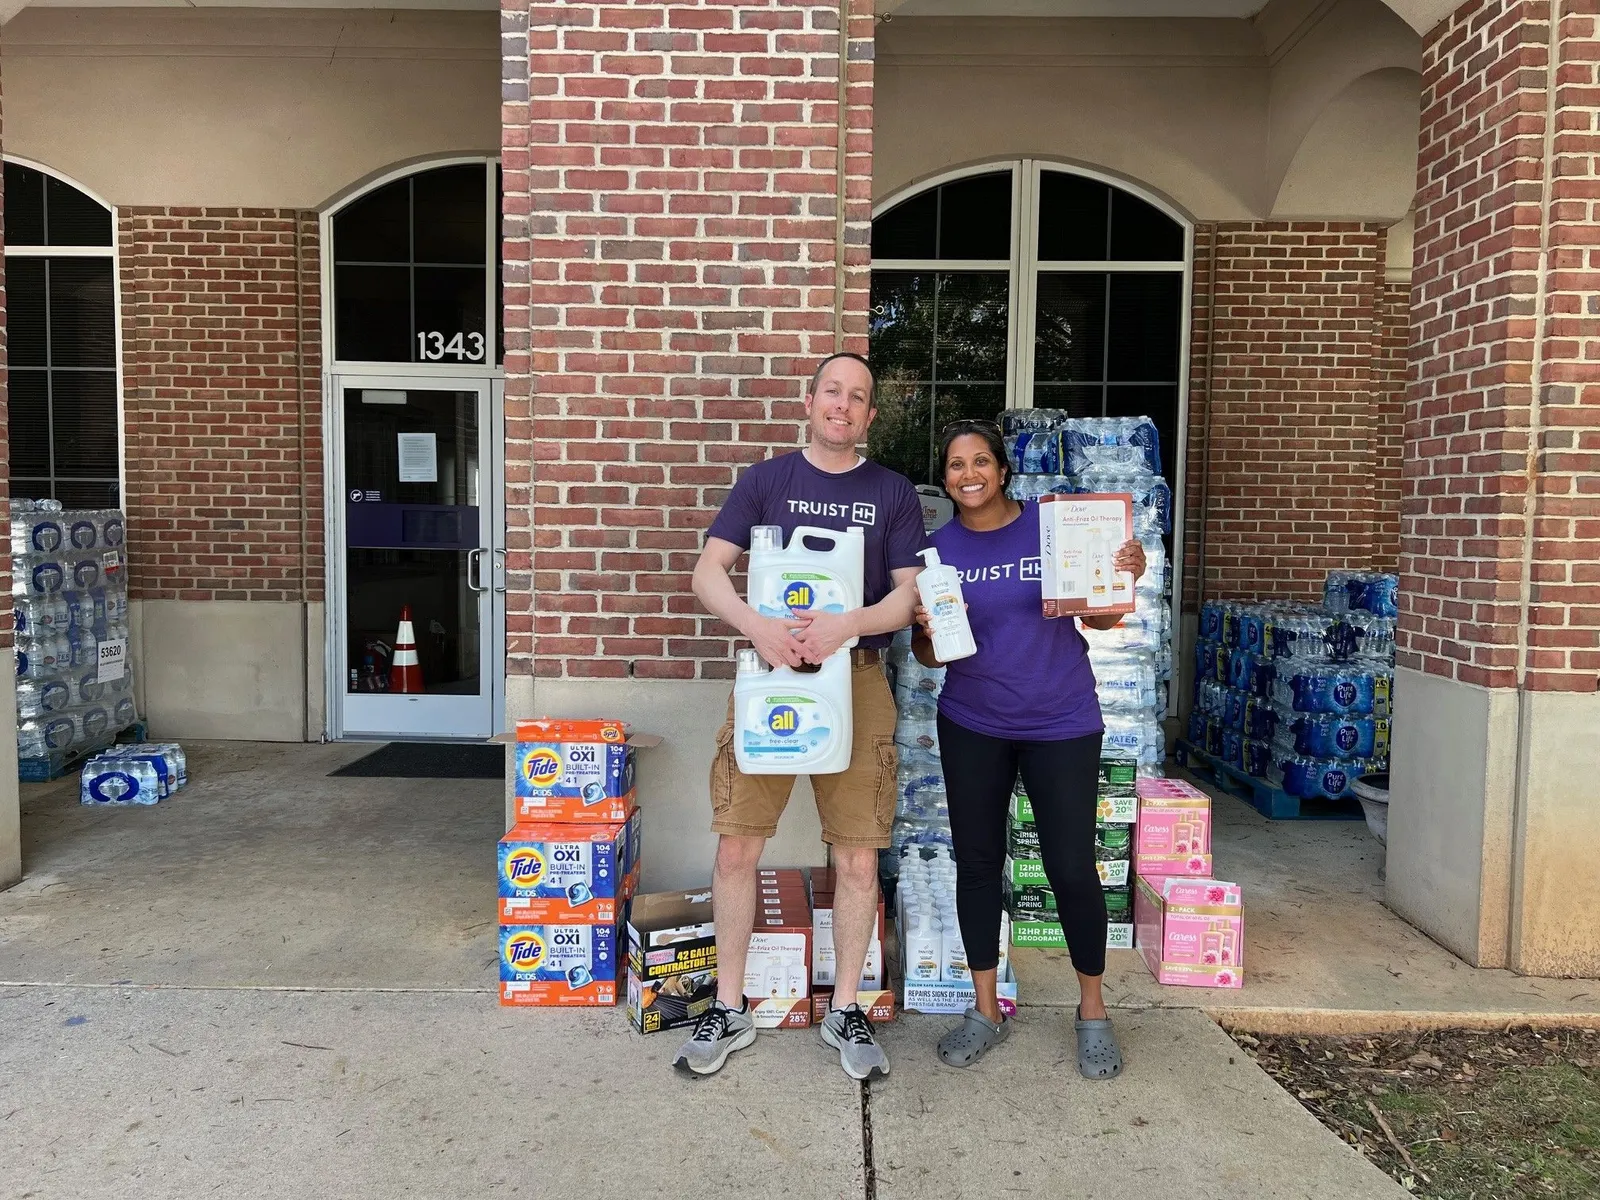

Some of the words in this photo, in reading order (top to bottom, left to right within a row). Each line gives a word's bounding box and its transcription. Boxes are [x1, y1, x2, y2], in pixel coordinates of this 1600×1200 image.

[417, 331, 485, 361] 1343
[787, 500, 849, 518] TRUIST
[1071, 505, 1087, 513] Dove
[957, 563, 1015, 584] RUIST
[787, 587, 809, 605] all
[101, 645, 121, 659] 53620
[1337, 685, 1353, 693] Pure
[1340, 691, 1352, 700] Life
[771, 711, 794, 730] all
[1341, 728, 1355, 736] Pure
[1107, 734, 1138, 744] WATER
[569, 751, 595, 762] OXI
[528, 757, 558, 779] Tide
[1327, 772, 1344, 780] Pure
[1328, 779, 1342, 788] Life
[1115, 806, 1132, 814] 20%
[1143, 824, 1169, 833] Caress
[554, 850, 580, 862] OXI
[510, 857, 542, 880] Tide
[550, 863, 586, 871] BUILT-IN
[1019, 864, 1041, 872] 12HR
[1108, 861, 1125, 869] SAVE
[1109, 868, 1124, 877] 20%
[1175, 887, 1198, 895] Caress
[1018, 927, 1040, 935] 12HR
[1043, 928, 1063, 936] FRES
[553, 934, 580, 945] OXI
[1109, 933, 1127, 941] 20%
[1168, 931, 1197, 942] Caress
[510, 941, 542, 964] Tide
[550, 946, 586, 954] BUILT-IN
[677, 950, 689, 960] 42
[690, 945, 716, 959] GALLO
[648, 957, 706, 977] CONTRACTOR
[932, 990, 948, 998] SIGNS
[646, 1013, 659, 1024] 24
